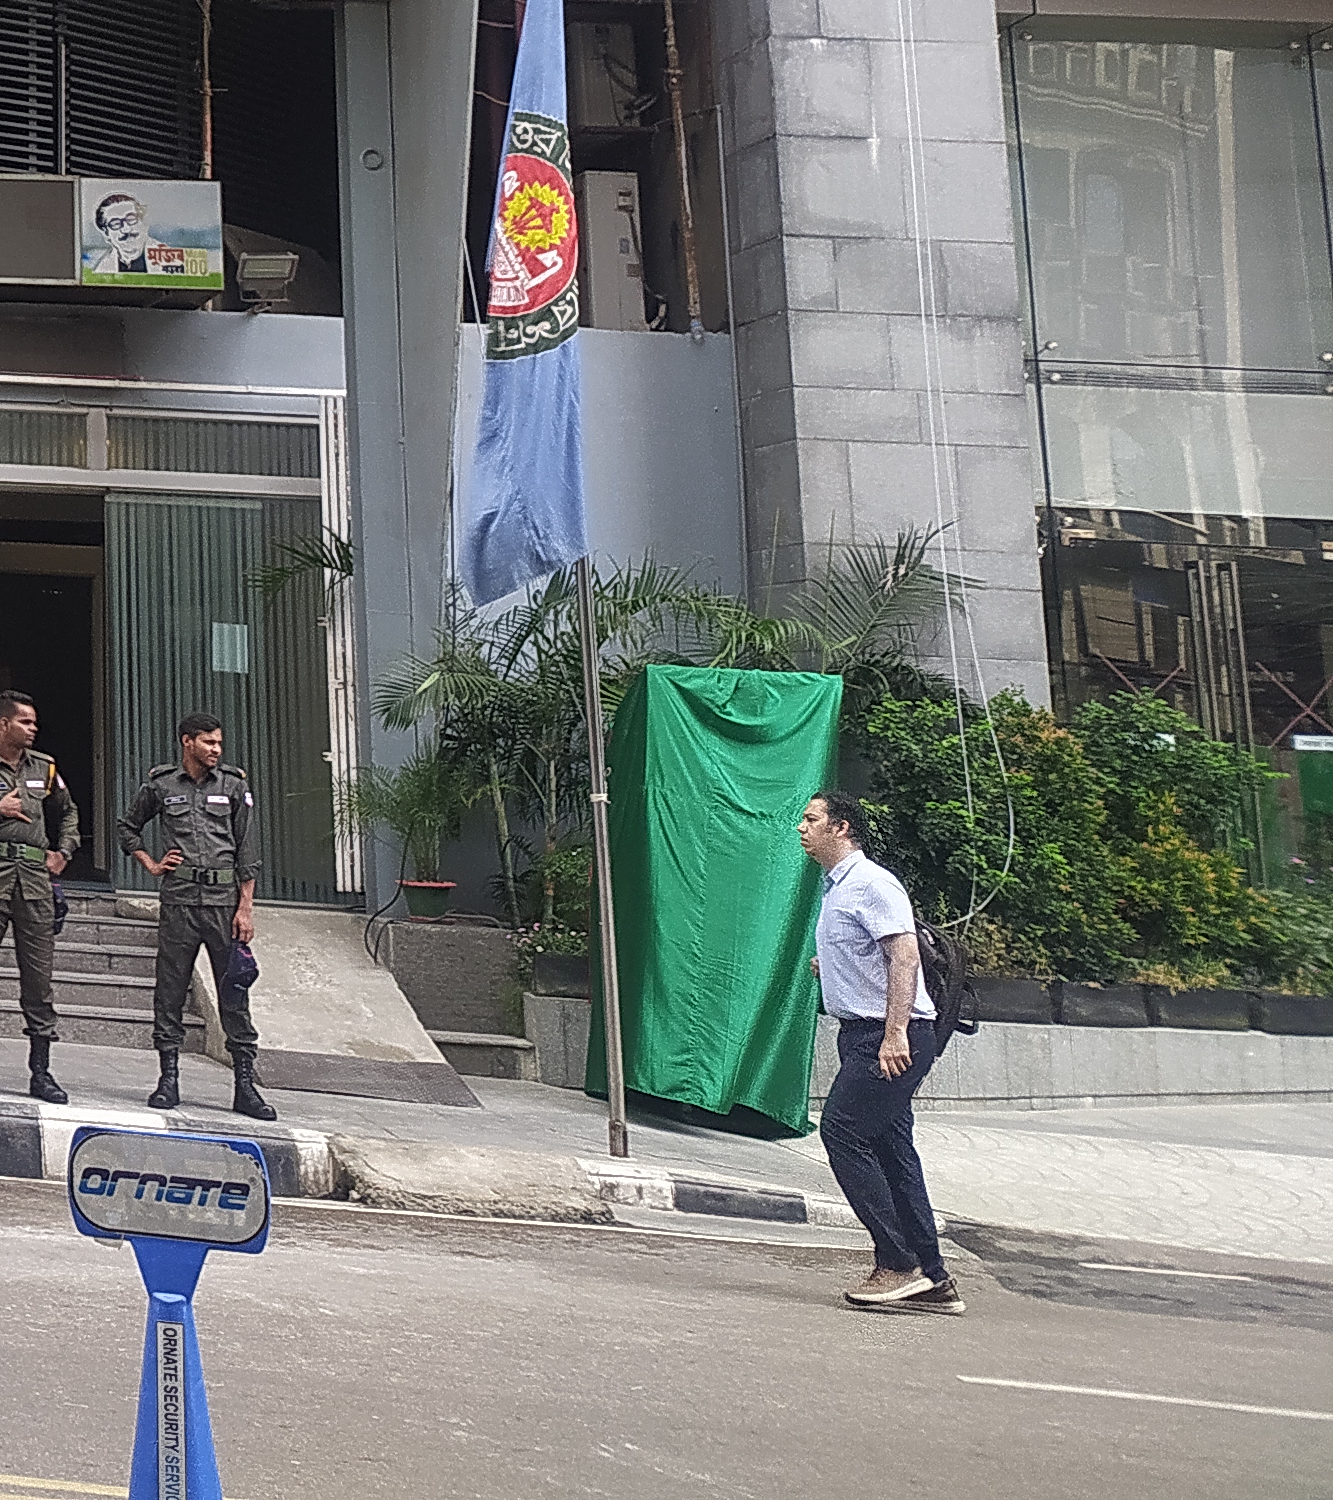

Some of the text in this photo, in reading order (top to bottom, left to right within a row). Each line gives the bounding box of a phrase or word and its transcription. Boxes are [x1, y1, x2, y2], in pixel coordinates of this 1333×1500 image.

[162, 1327, 182, 1500] ORNATE SECURITY SERVIC
